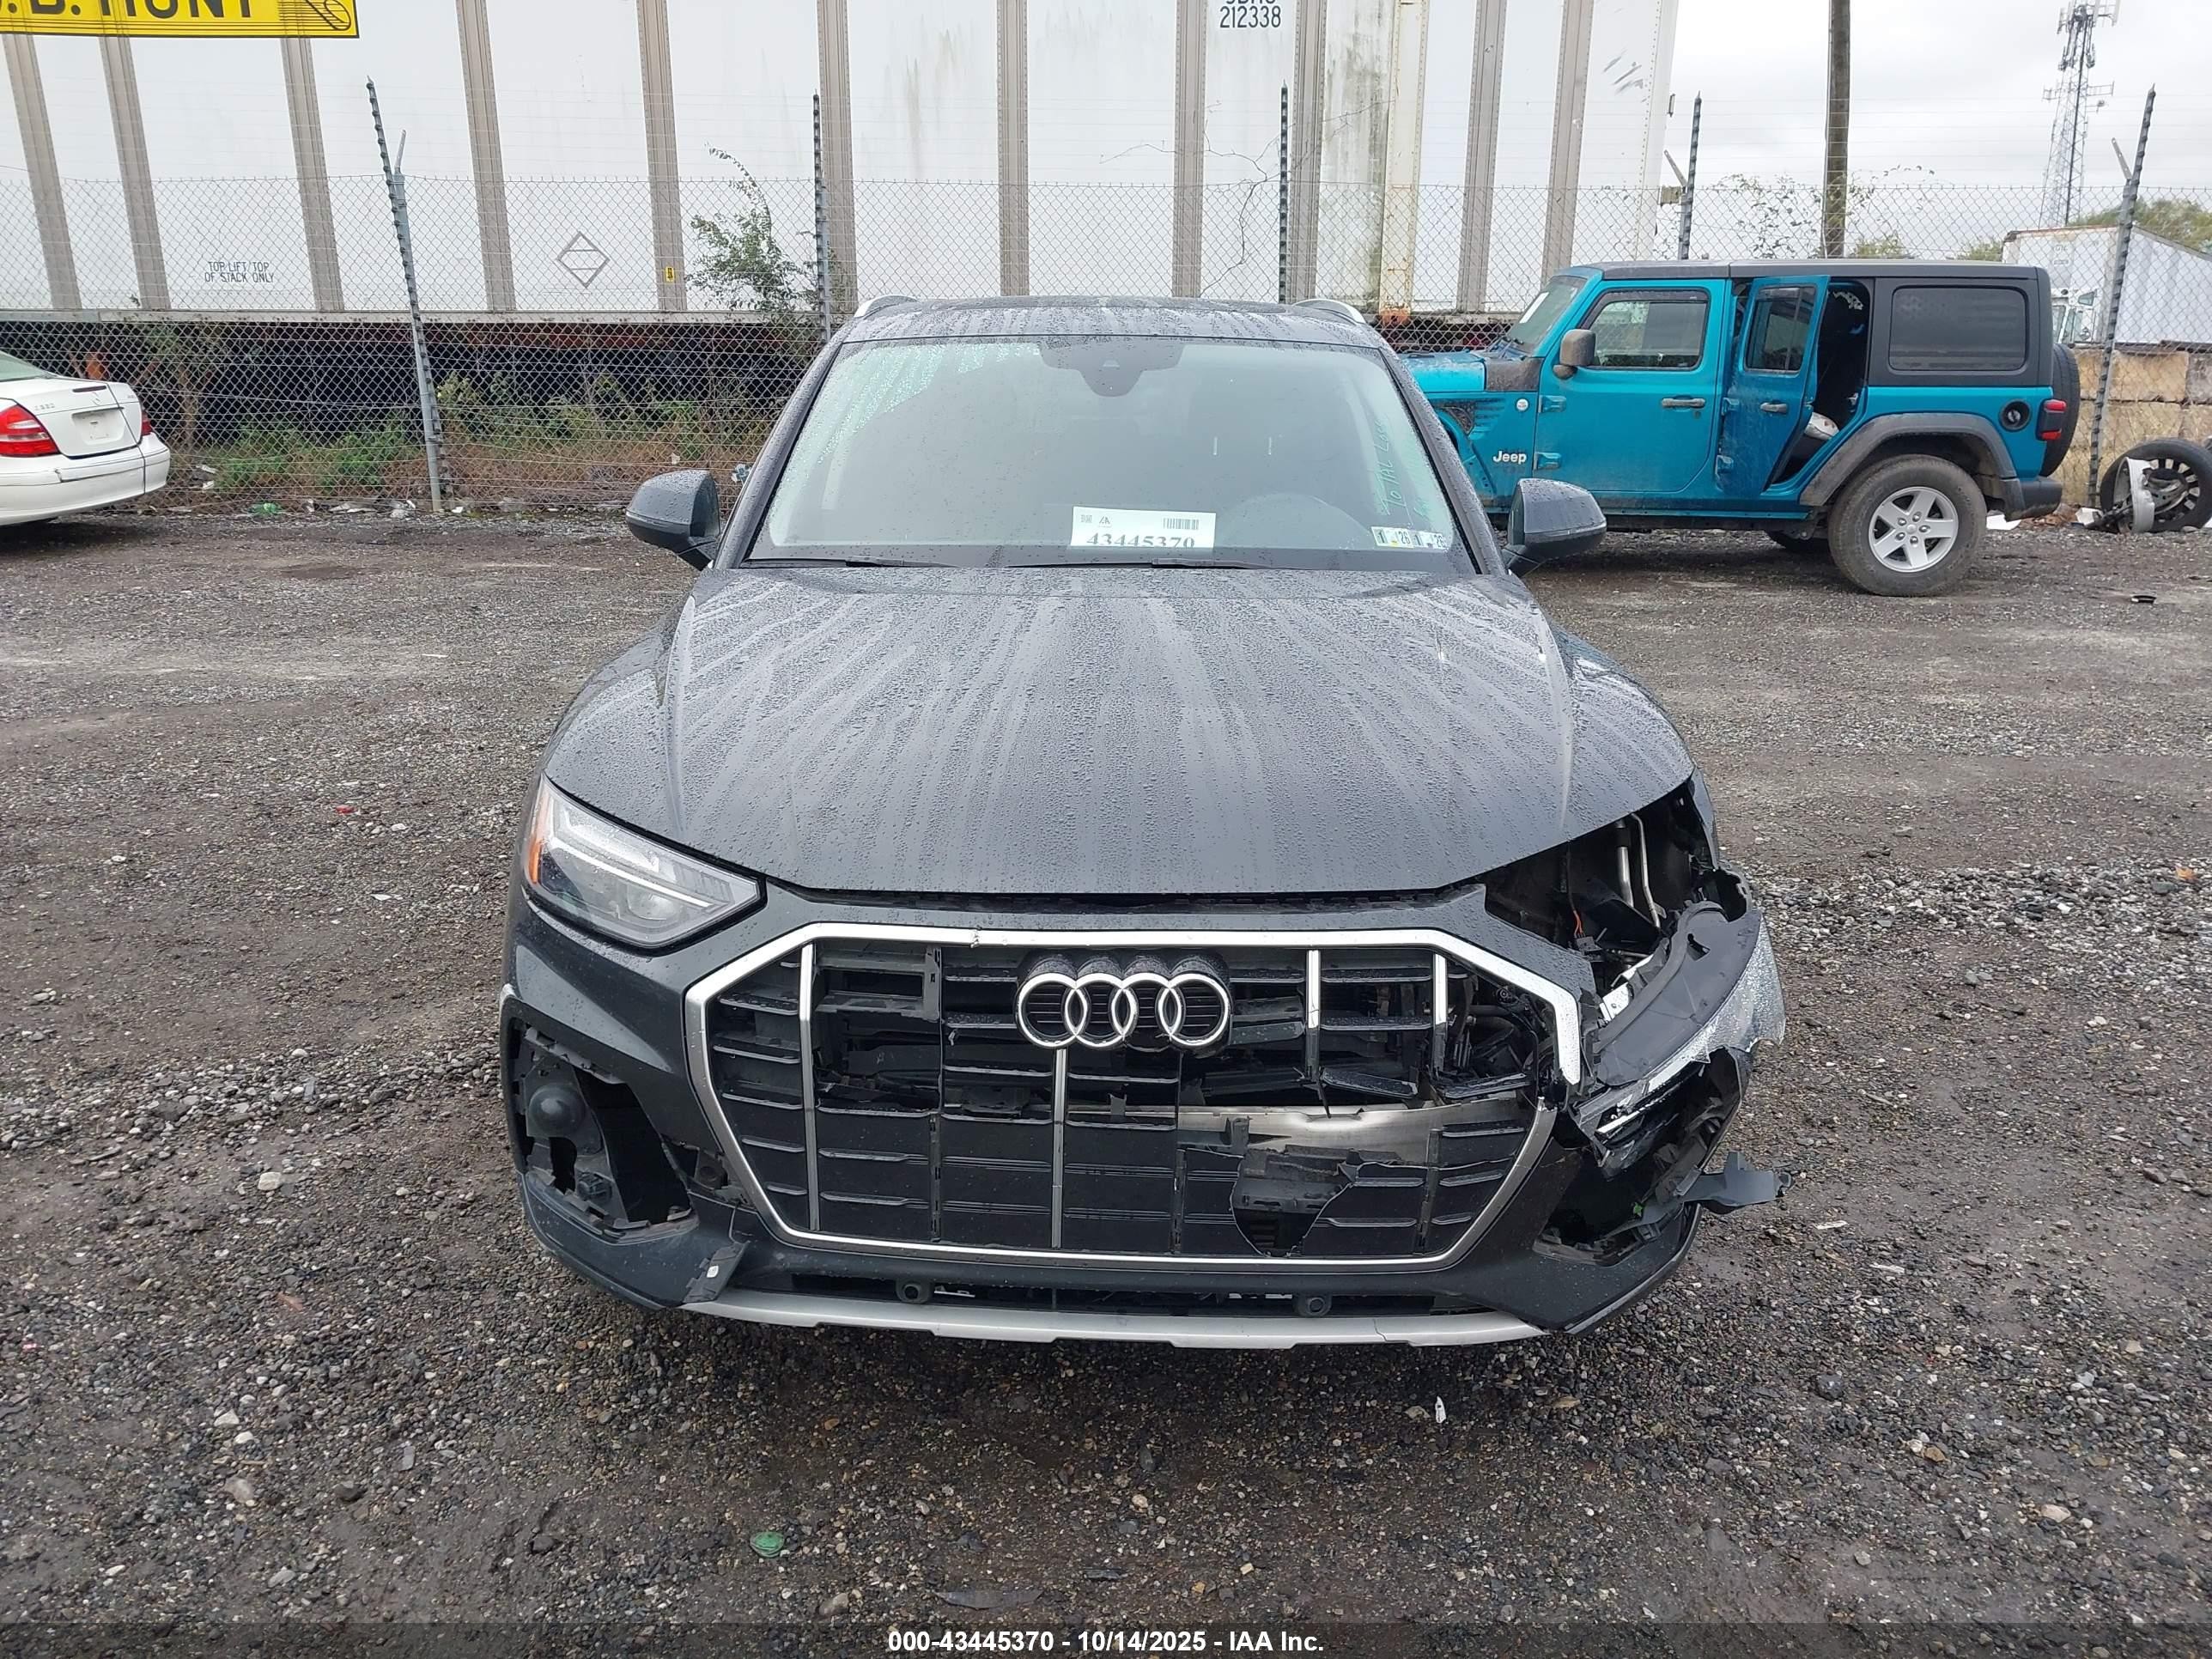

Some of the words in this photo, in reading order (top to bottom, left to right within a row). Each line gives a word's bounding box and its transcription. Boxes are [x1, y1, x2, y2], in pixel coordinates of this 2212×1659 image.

[1219, 5, 1281, 28] 212338
[207, 261, 225, 272] TOP
[228, 261, 246, 272] LIFT
[252, 261, 270, 272] TOP
[204, 271, 216, 283] OF
[220, 271, 247, 283] STACK
[252, 271, 274, 283] ONLY
[1492, 450, 1528, 465] Jeep
